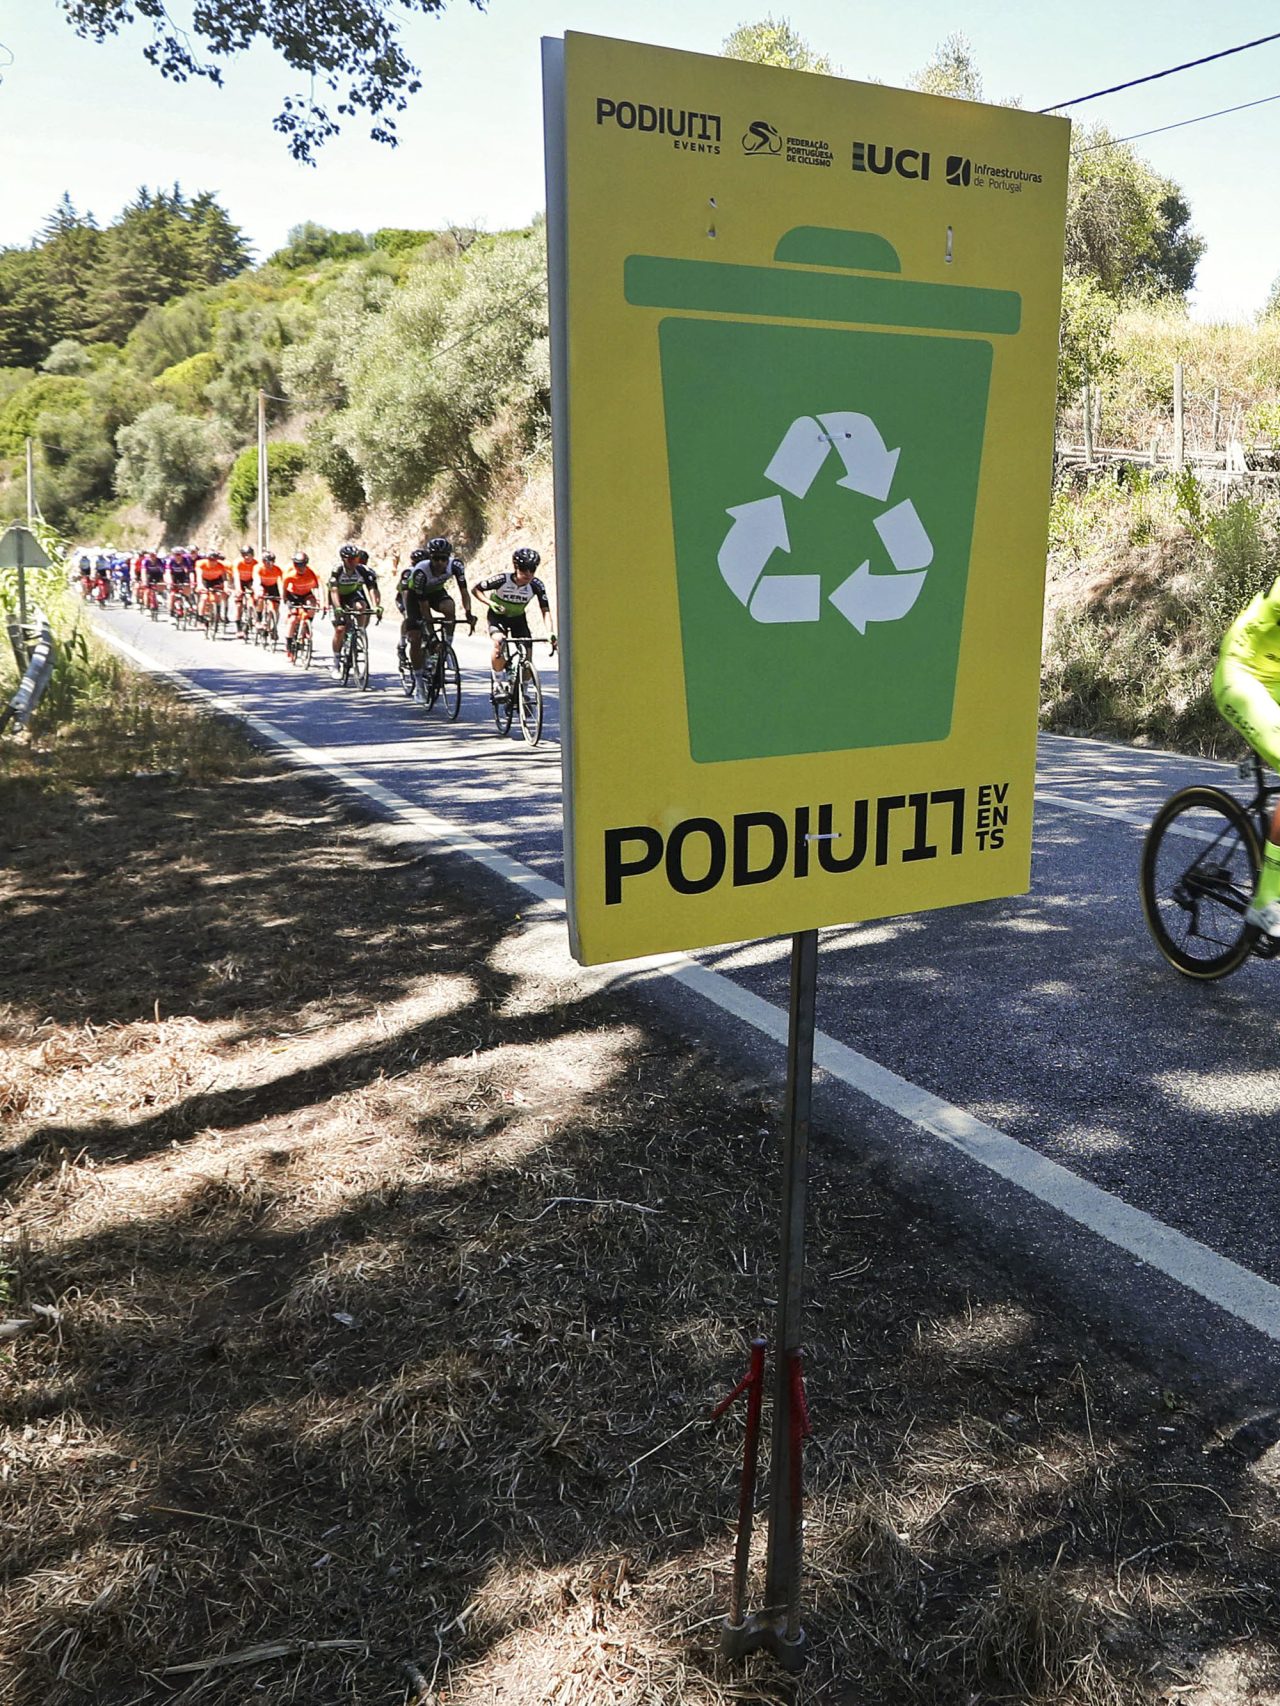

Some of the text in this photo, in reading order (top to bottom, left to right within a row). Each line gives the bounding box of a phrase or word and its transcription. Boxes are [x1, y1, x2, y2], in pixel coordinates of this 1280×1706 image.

[674, 141, 720, 154] EVENTS
[787, 137, 829, 150] FEDERAÇÃO
[786, 147, 833, 160] PORTUGUESA
[786, 154, 831, 167] DE CICLISMO
[974, 163, 1042, 183] Infraestruturas
[974, 177, 1022, 193] de Portugal
